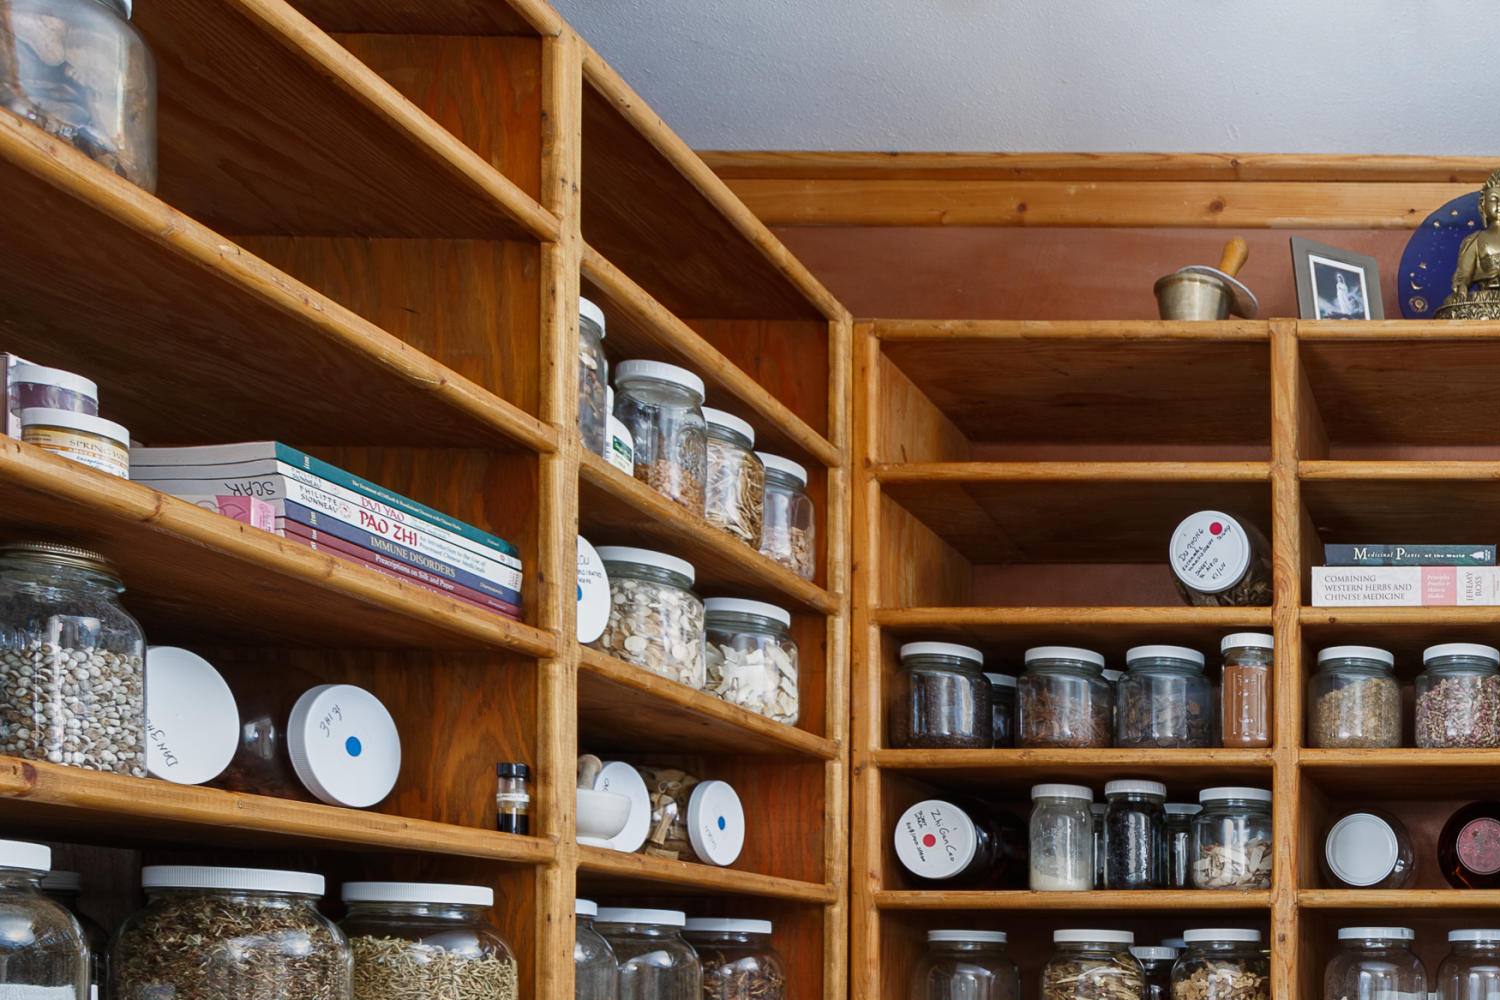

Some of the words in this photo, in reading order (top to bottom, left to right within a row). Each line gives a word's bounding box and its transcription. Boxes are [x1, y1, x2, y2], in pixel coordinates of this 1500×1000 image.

[359, 510, 389, 534] PAO
[393, 524, 418, 547] ZHI
[370, 536, 409, 560] IMMUNE
[409, 551, 456, 578] DISORDERS
[1353, 548, 1393, 560] Medicinal
[1395, 548, 1420, 560] Plants
[1324, 575, 1376, 583] COMBINING
[1465, 571, 1473, 601] JEREMY
[1475, 576, 1483, 597] ROSS
[1324, 584, 1363, 592] WESTERN
[1393, 583, 1412, 591] AND
[1324, 592, 1362, 601] CHINESE
[1363, 592, 1406, 600] MEDICINE
